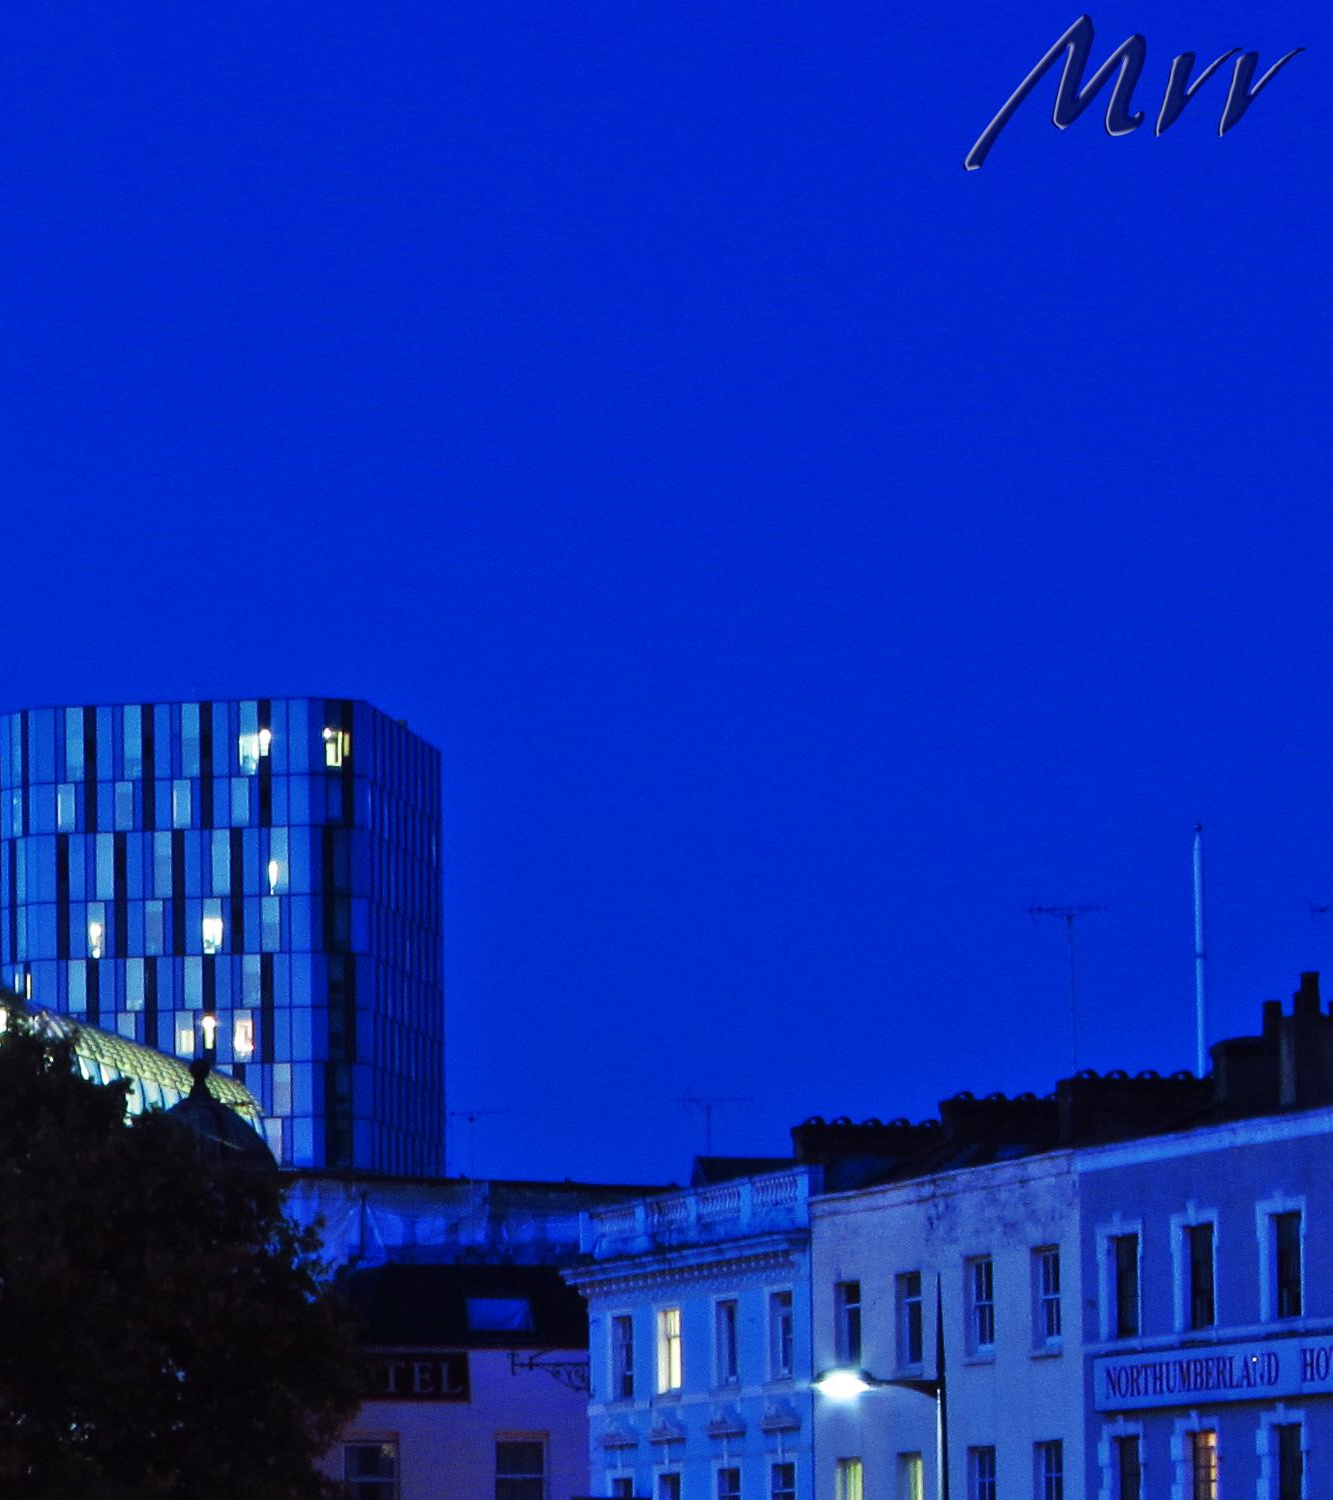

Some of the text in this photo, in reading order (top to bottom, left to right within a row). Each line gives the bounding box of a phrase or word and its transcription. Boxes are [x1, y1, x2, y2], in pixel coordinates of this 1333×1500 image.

[365, 1360, 463, 1394] TEL
[1105, 1344, 1333, 1400] NORTHUMBERLAND HO
